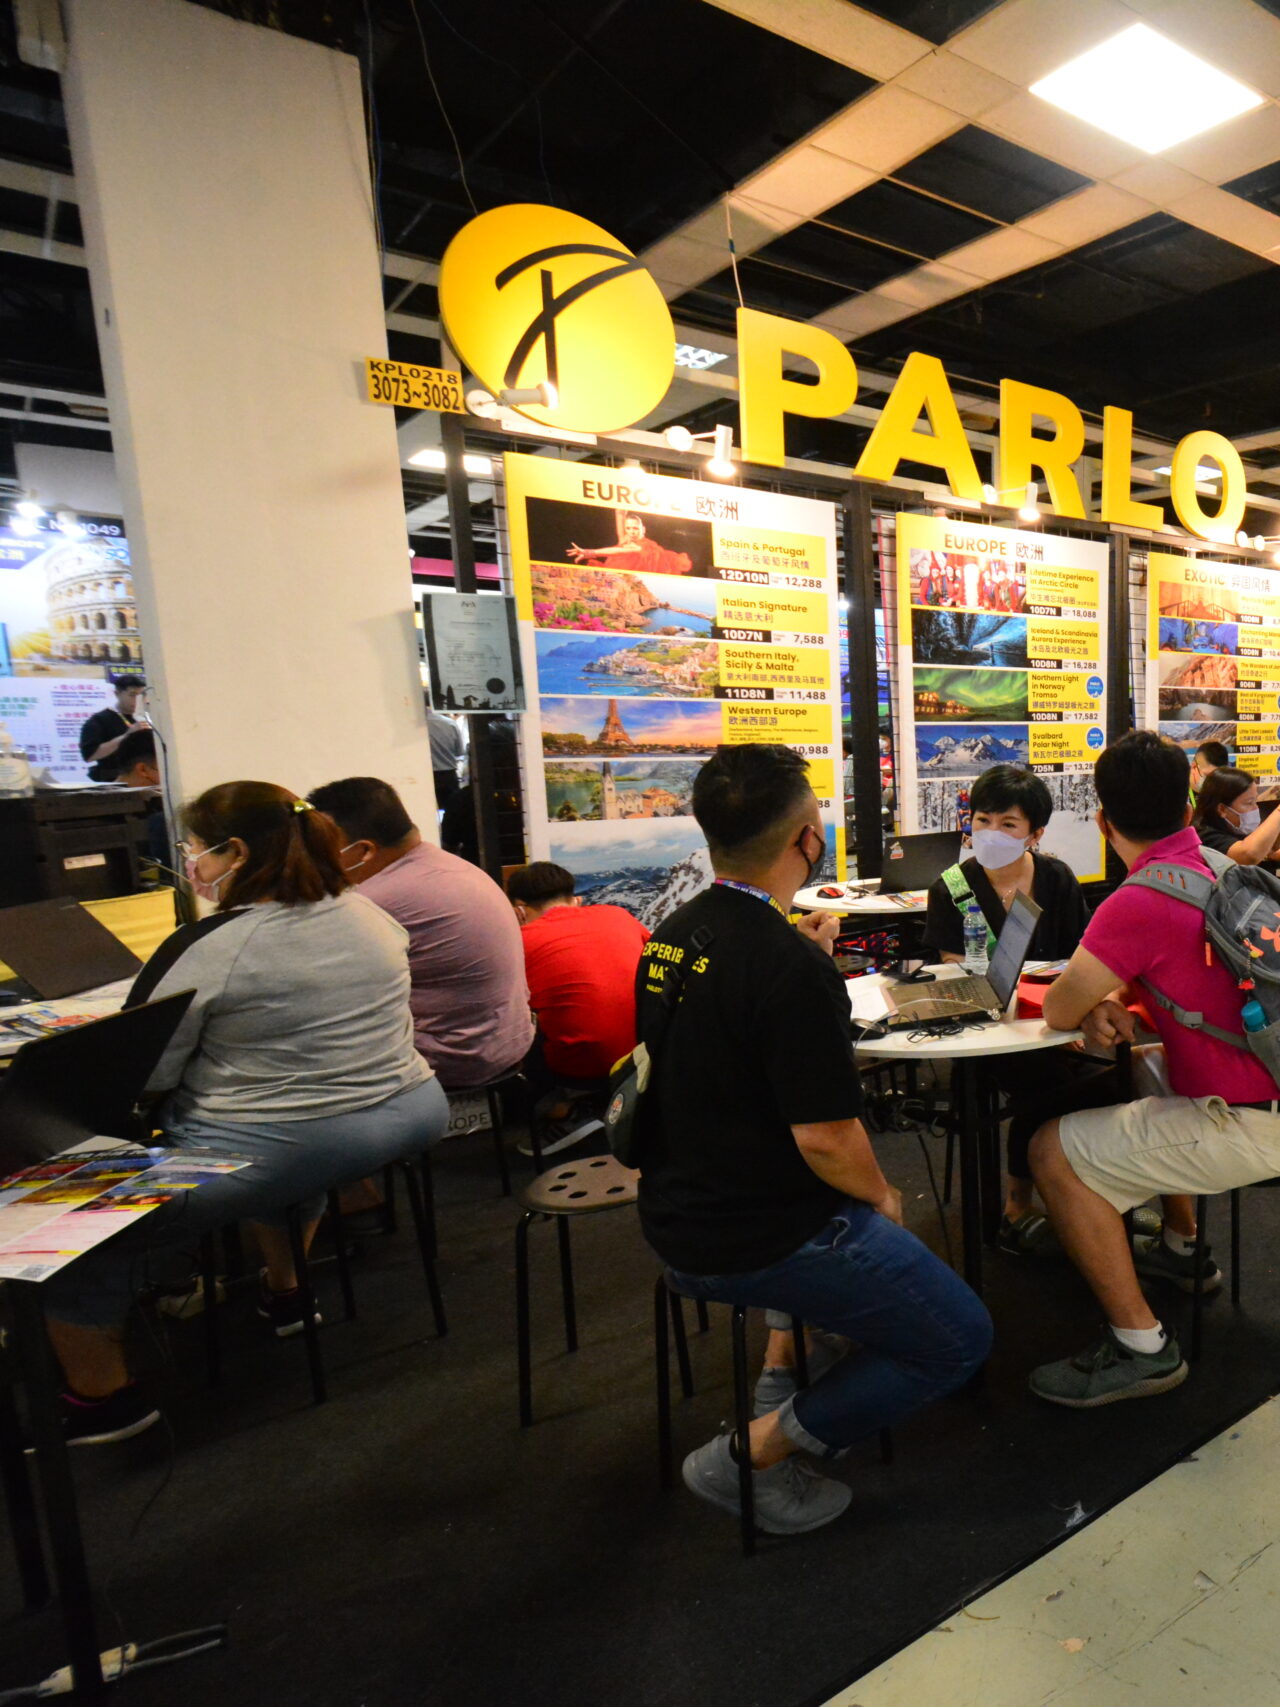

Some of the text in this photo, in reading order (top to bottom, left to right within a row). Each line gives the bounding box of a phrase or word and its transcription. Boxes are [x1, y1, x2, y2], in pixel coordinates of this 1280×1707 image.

[370, 360, 458, 385] KPL0218
[371, 374, 460, 410] 3073~3082
[736, 307, 1247, 542] PARLO
[582, 480, 681, 511] EURO
[696, 496, 739, 521] 欧洲
[720, 538, 805, 557] Spain & Portugal
[944, 533, 1007, 556] EUROPE
[1015, 543, 1044, 561] 欧洲
[719, 569, 768, 583] 12D10N
[1058, 571, 1095, 582] Experience
[1184, 568, 1226, 585] EXOTIC
[785, 576, 822, 588] 12,288
[1038, 579, 1058, 587] Arctic
[1060, 580, 1079, 589] Circle
[722, 598, 808, 612] Italian Signature
[722, 629, 763, 641] 10D7N
[1031, 627, 1054, 635] Iceland
[1061, 630, 1098, 638] Scandinavia
[793, 634, 824, 645] 7,588
[1053, 637, 1086, 645] Experience
[725, 649, 773, 660] Southern
[725, 660, 794, 671] Sicily & Malta
[1063, 675, 1079, 684] Light
[1039, 683, 1066, 692] Norway
[725, 688, 766, 699] 11D8N
[789, 690, 826, 701] 11,488
[1032, 691, 1058, 699] Tromso
[728, 706, 807, 718] Western Europe
[1032, 732, 1063, 740] Svalbard
[1051, 741, 1070, 750] Night
[1073, 763, 1094, 771] 13,28
